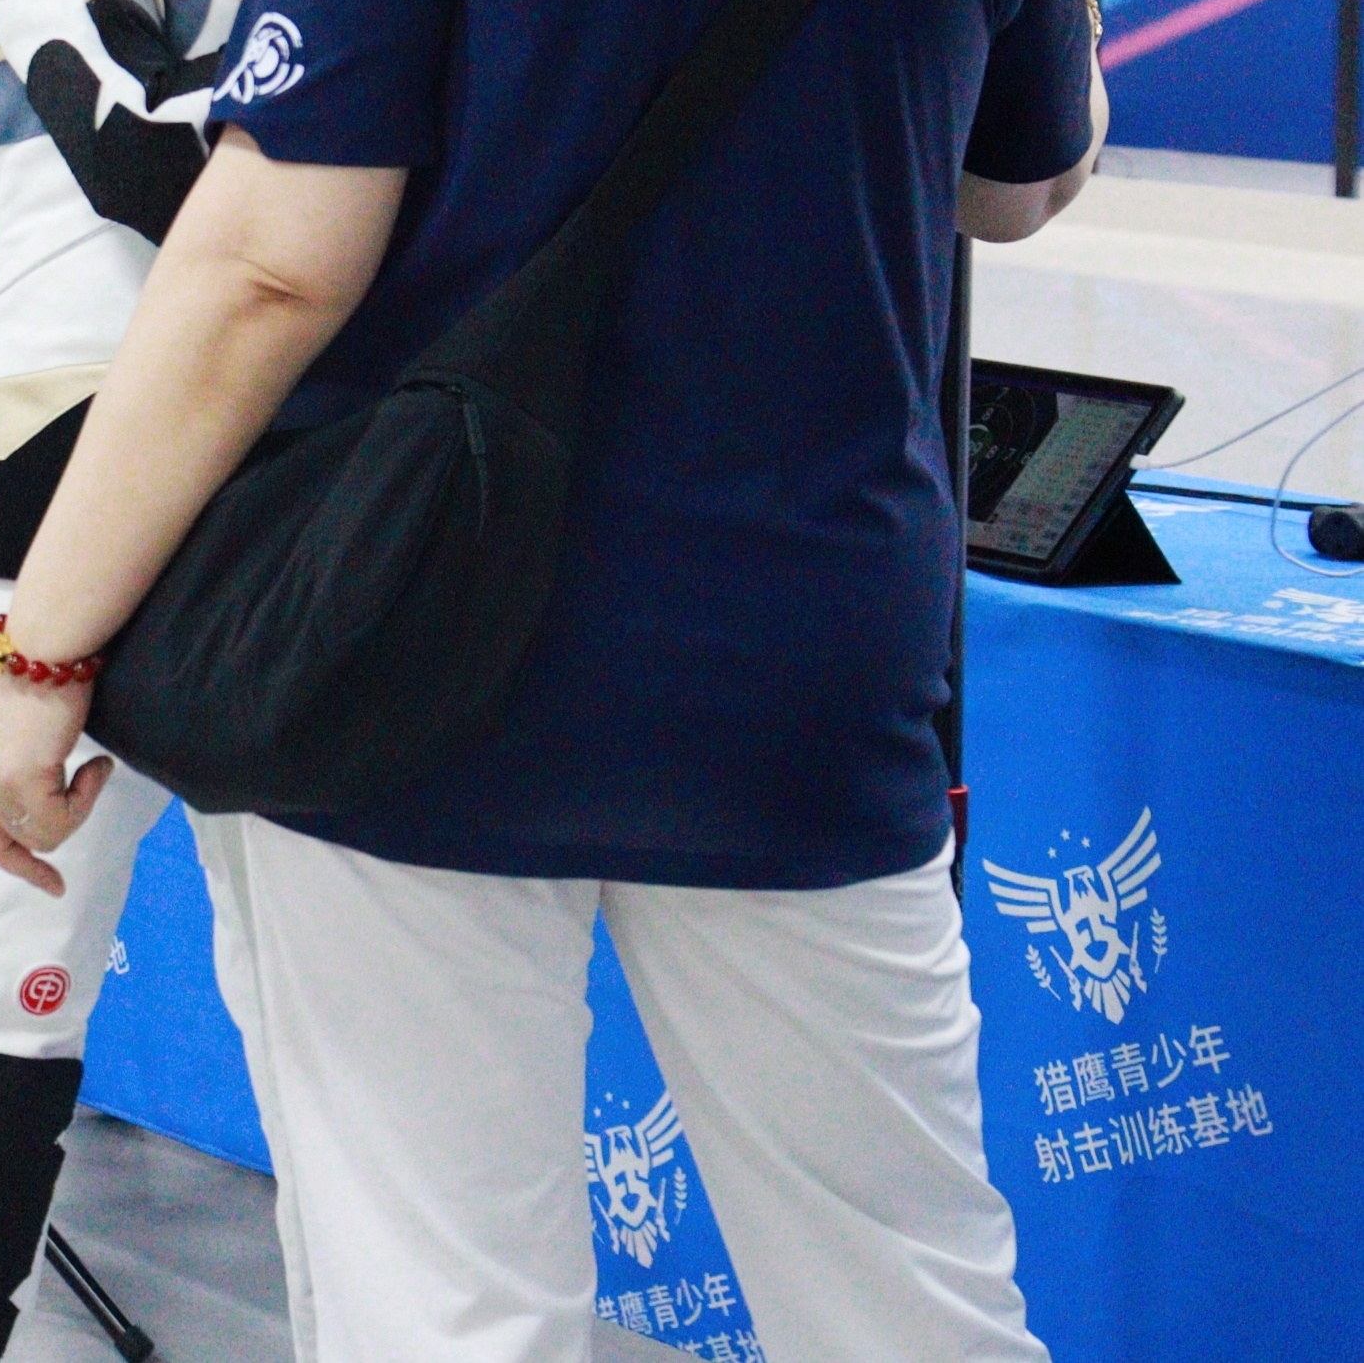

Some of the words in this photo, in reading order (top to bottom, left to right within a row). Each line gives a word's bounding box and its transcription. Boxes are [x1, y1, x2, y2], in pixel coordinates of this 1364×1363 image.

[1033, 1023, 1232, 1117] 猎鹰青少年
[1034, 1082, 1275, 1185] 射击训练基地
